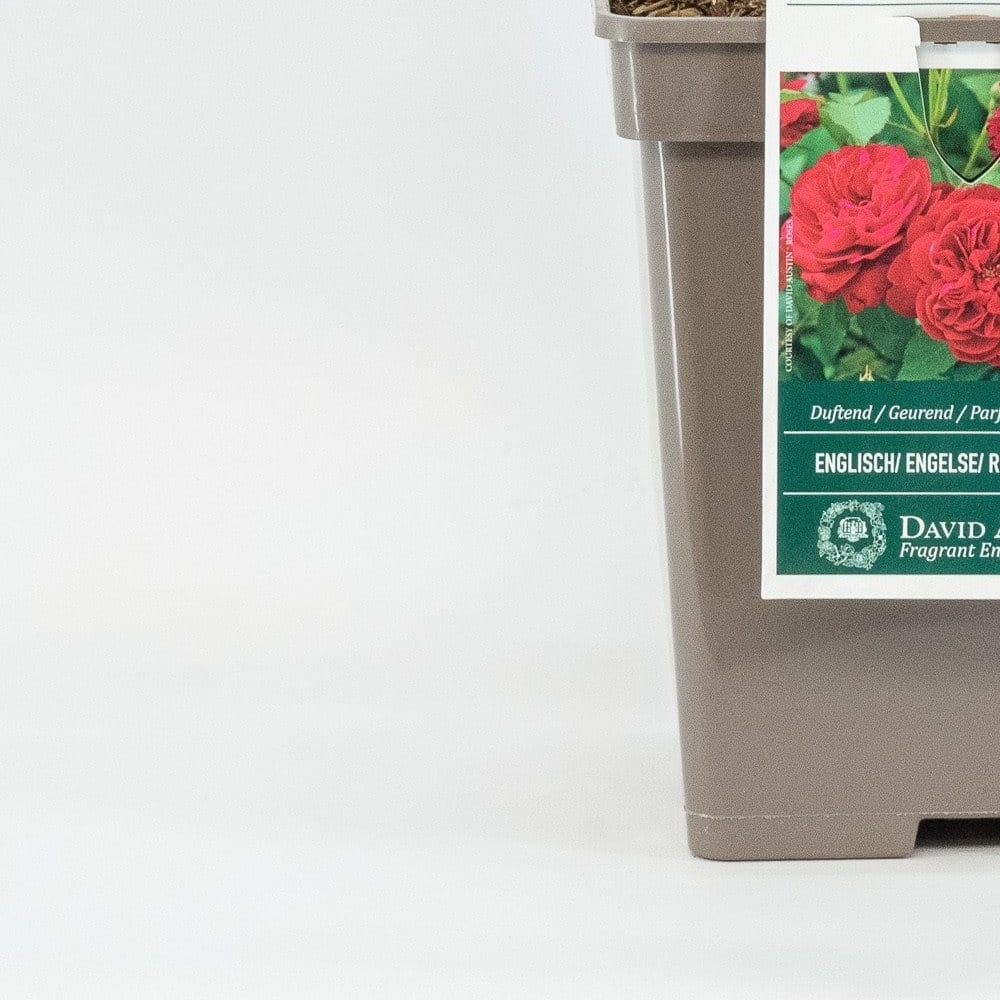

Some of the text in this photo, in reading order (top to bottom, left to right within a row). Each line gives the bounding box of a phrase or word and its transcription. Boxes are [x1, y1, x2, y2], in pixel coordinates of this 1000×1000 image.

[785, 284, 793, 314] DAVID
[785, 314, 793, 326] OF
[785, 327, 793, 372] COURTESY
[810, 404, 873, 421] Duftend
[888, 404, 954, 420] Geurend
[815, 452, 902, 474] ENGLISCH/
[905, 452, 985, 474] ENGELSE/
[899, 515, 986, 539] DAVID
[899, 542, 976, 561] Fragrant
